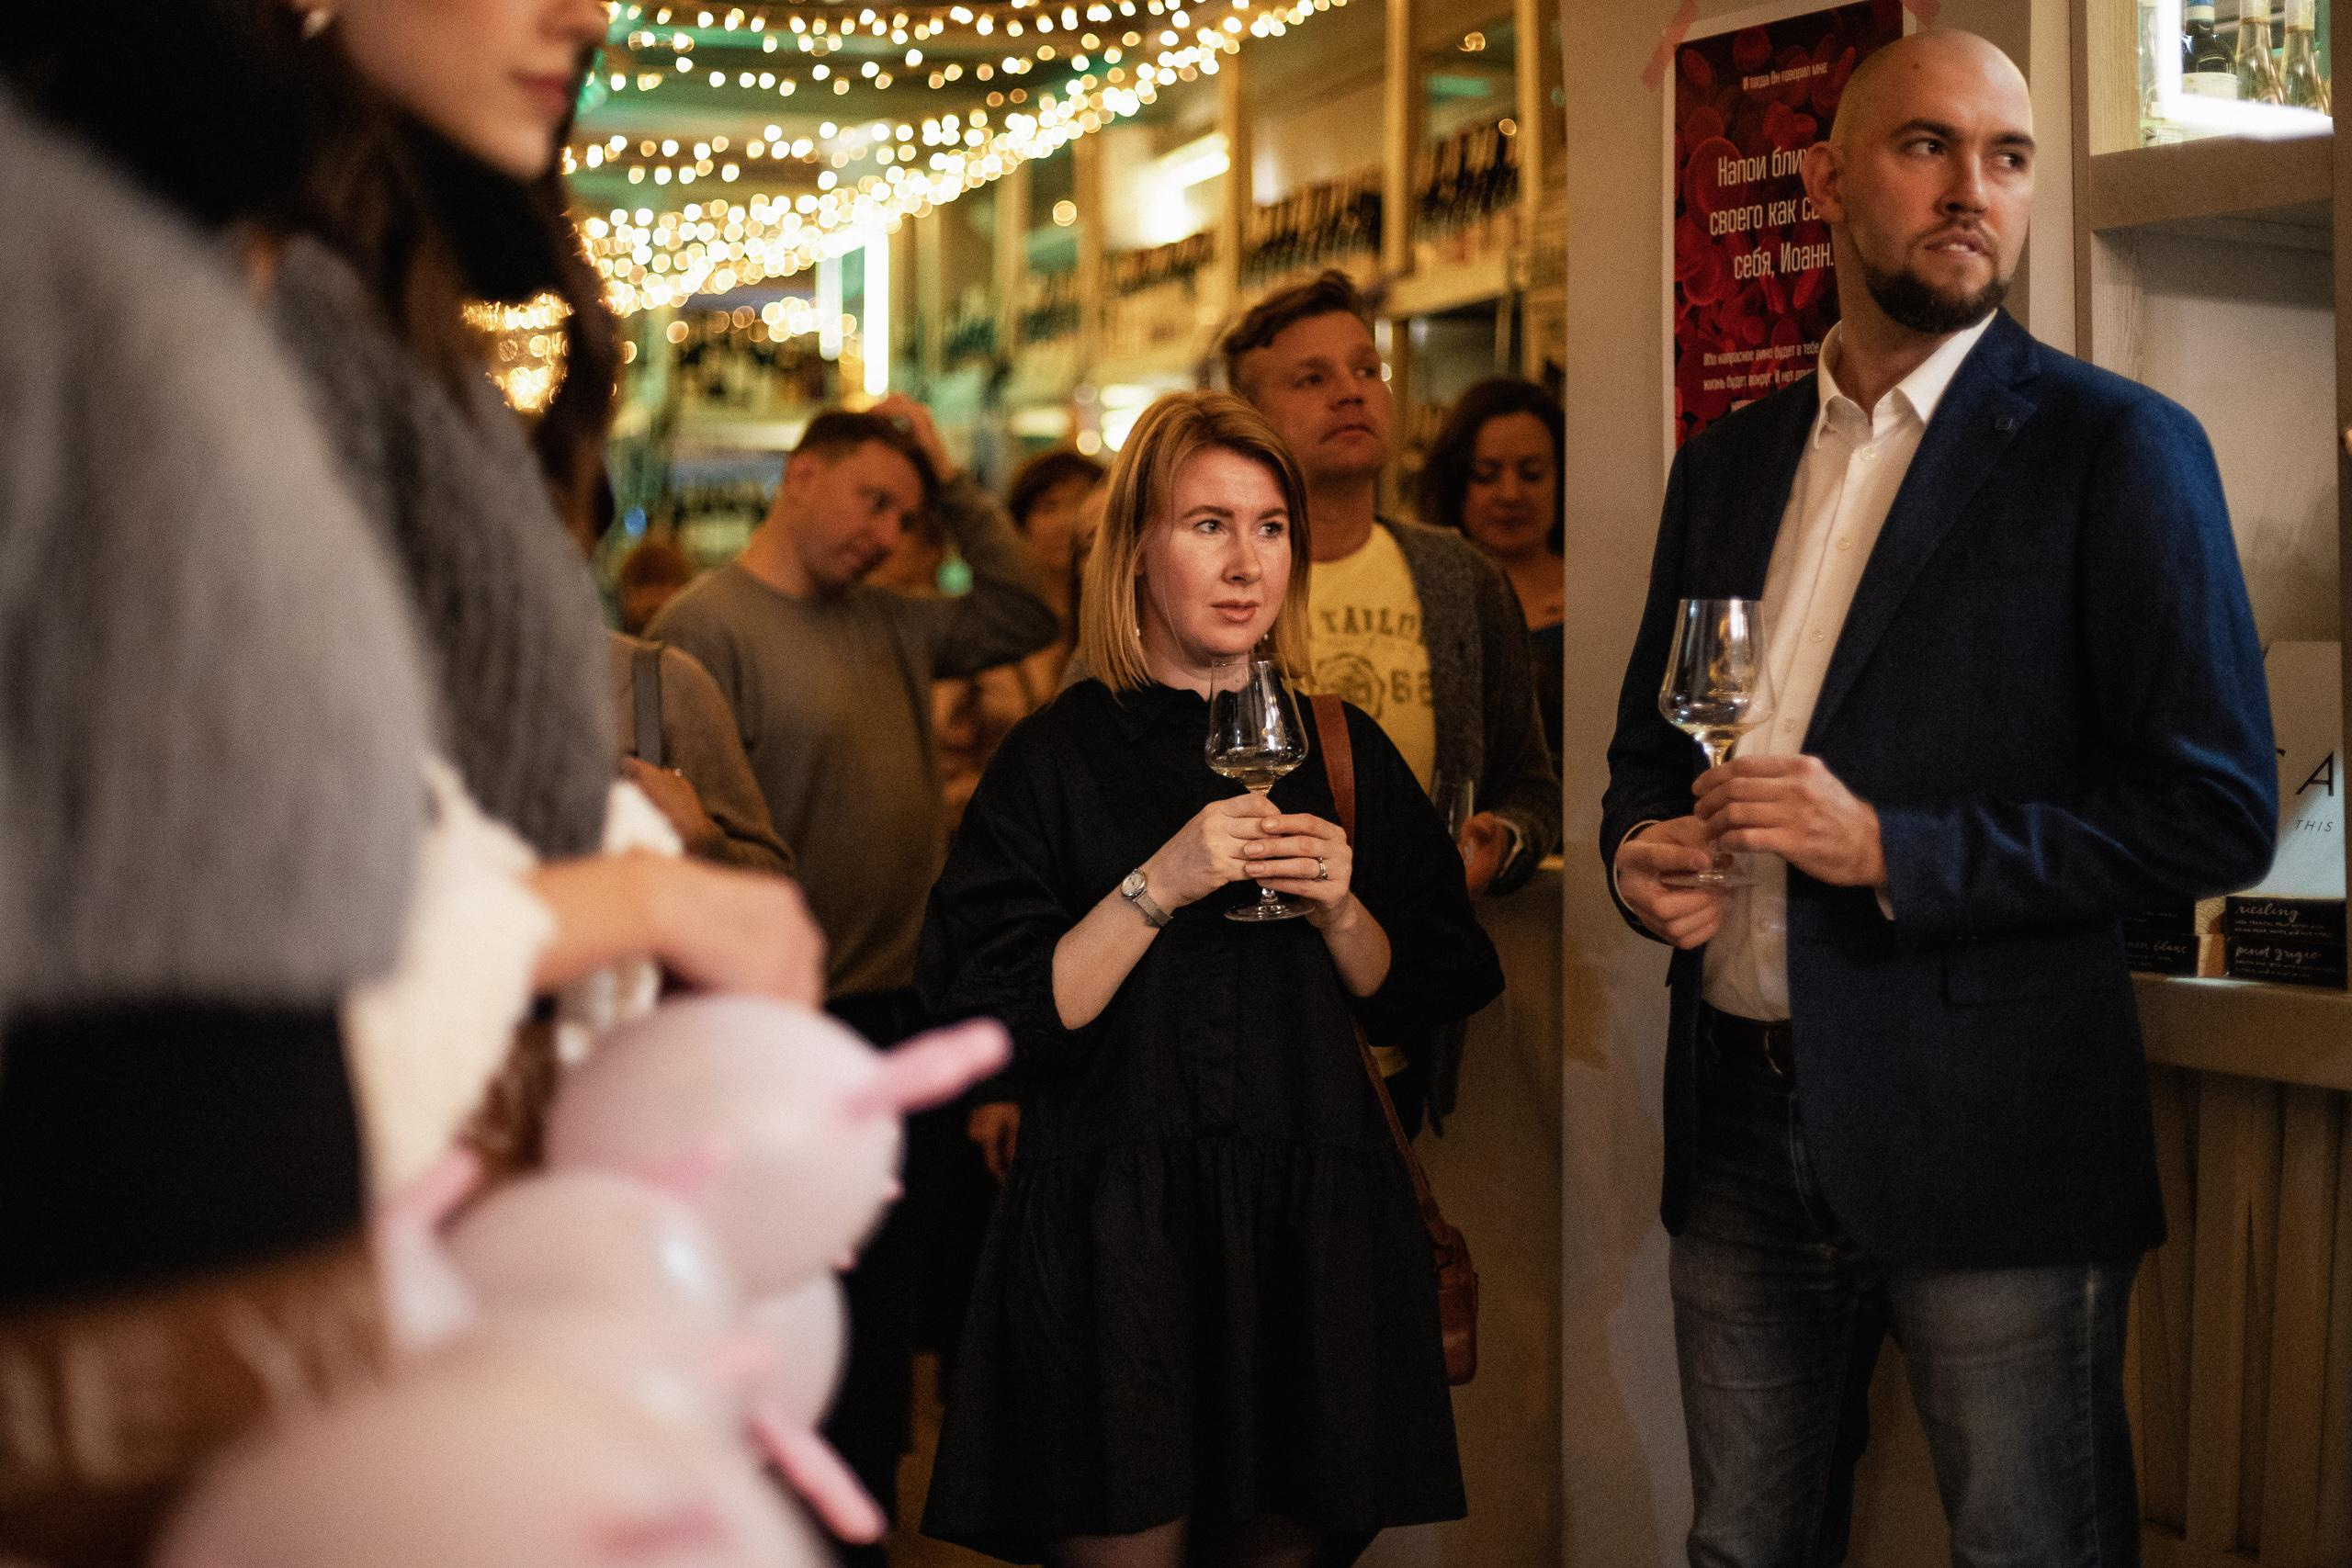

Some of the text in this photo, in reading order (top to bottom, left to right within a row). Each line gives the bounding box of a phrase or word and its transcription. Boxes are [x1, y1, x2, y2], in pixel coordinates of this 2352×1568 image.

[1718, 155, 1767, 186] Напои
[1710, 203, 1763, 236] своего
[1768, 198, 1797, 227] как
[1735, 242, 1834, 279] себя, Иоанн.
[1320, 606, 1418, 641] TAILO
[2295, 819, 2334, 833] THIS
